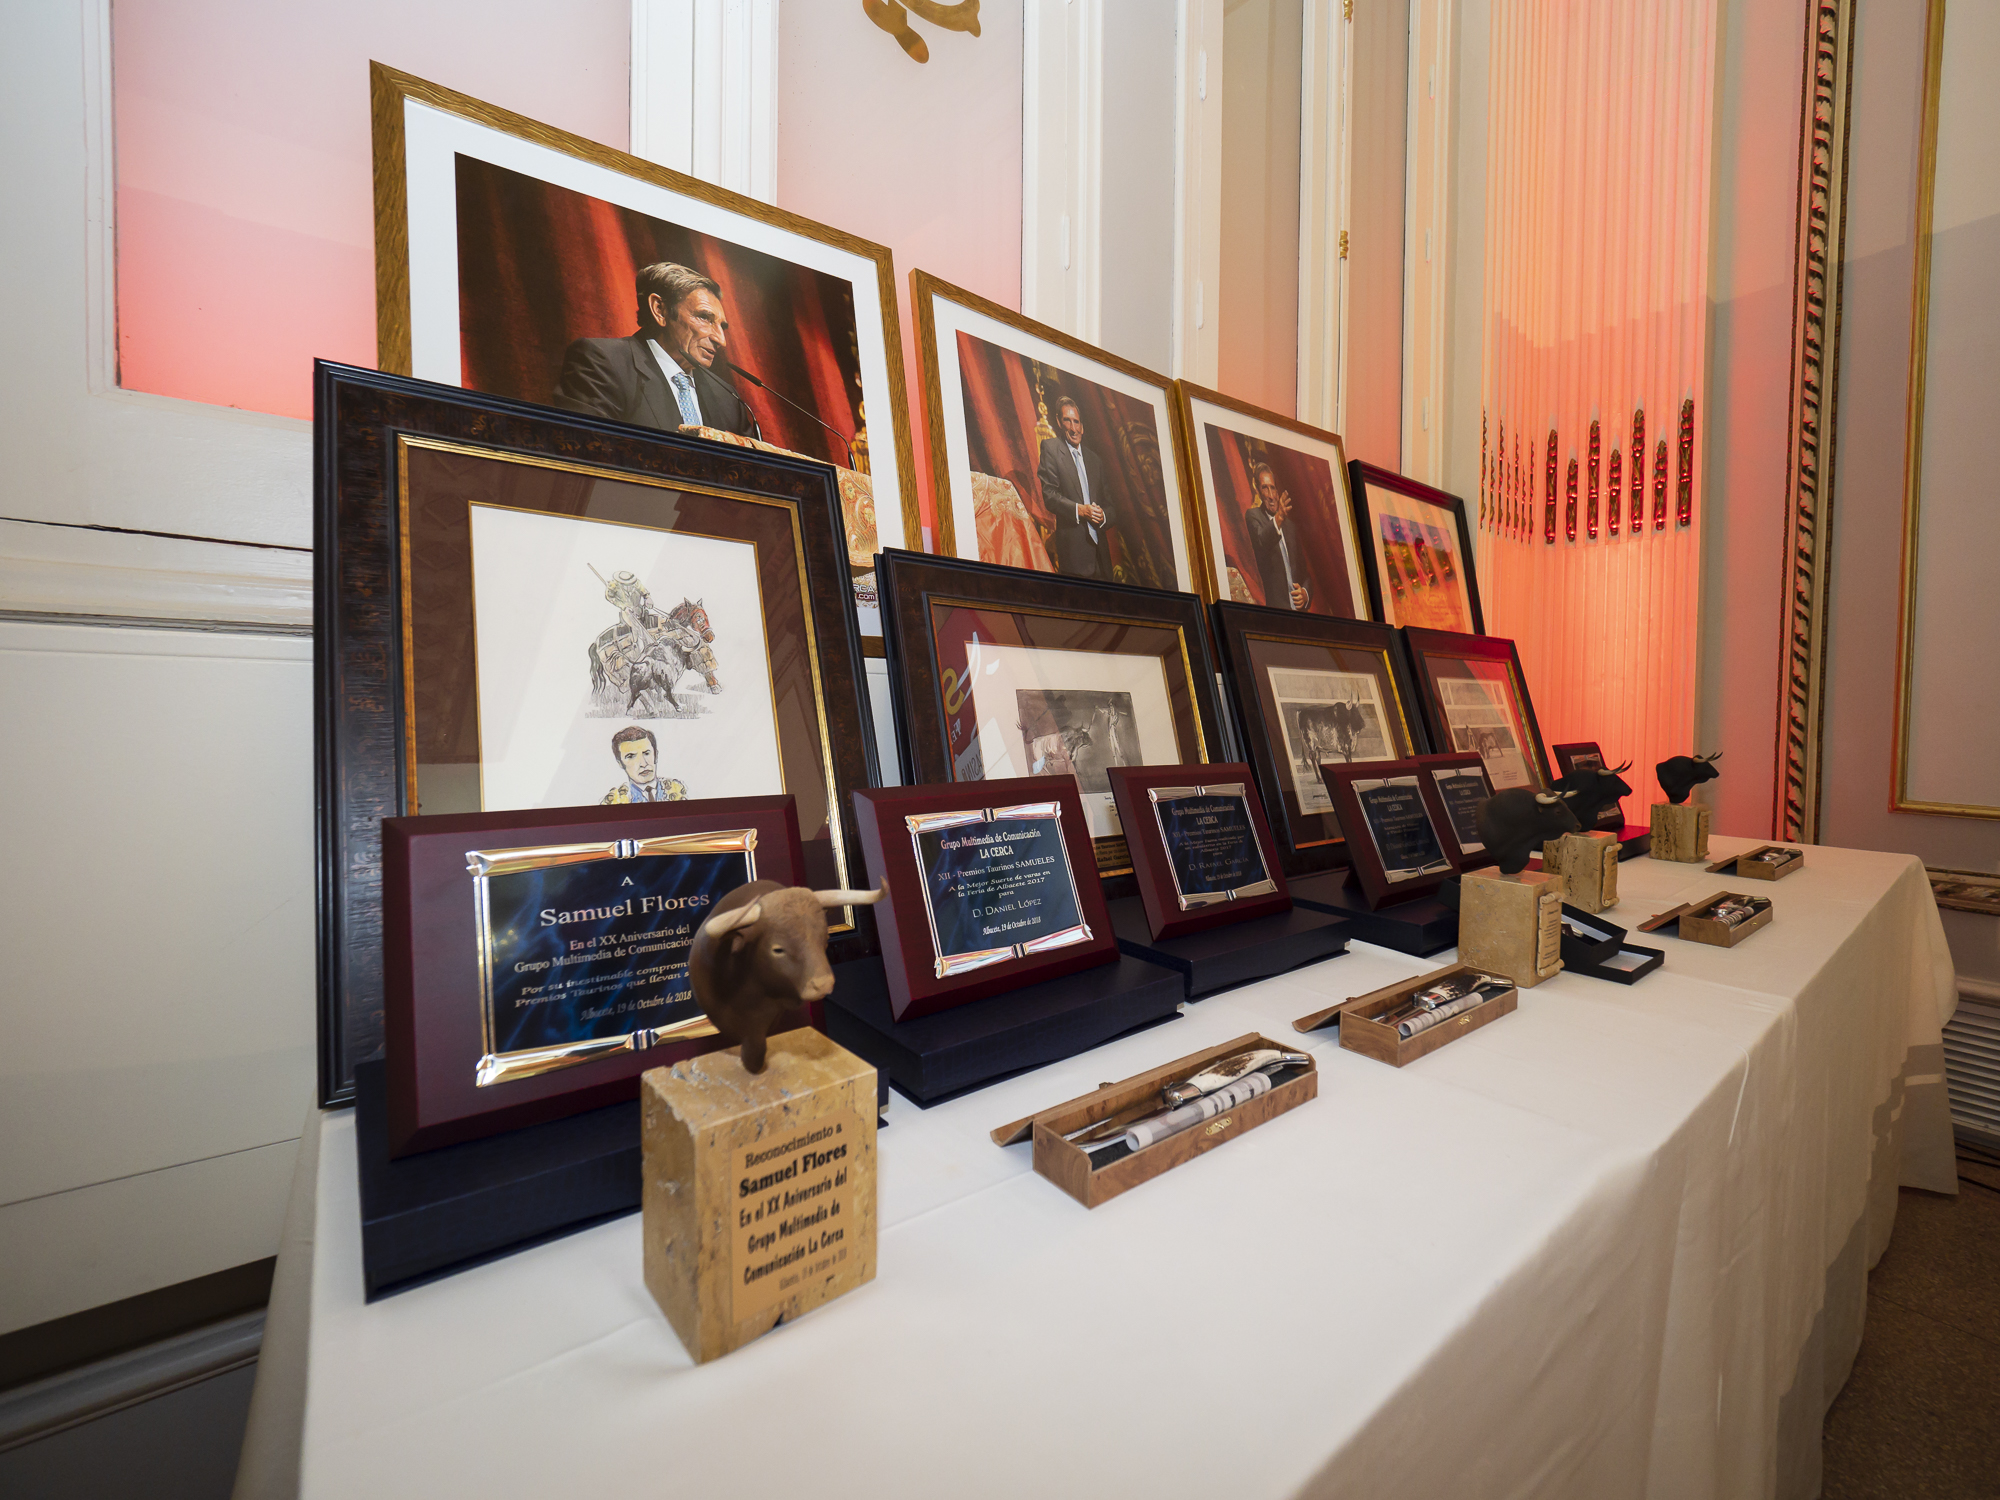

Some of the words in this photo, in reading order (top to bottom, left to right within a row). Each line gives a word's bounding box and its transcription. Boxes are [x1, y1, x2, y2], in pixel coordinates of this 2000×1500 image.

[1195, 817, 1203, 825] LA
[1203, 815, 1219, 824] CERCA
[940, 839, 961, 850] Grupo
[961, 834, 995, 847] Multimedia
[995, 833, 1003, 842] de
[1003, 828, 1042, 842] Comunicación
[979, 848, 990, 859] LA
[990, 845, 1014, 857] CERCA
[937, 871, 951, 881] XII
[957, 867, 986, 878] Premios
[986, 863, 1015, 874] Taurinos
[1015, 855, 1055, 868] SAMUELES
[966, 881, 989, 890] Mejor
[990, 877, 1014, 885] Suerte
[1023, 872, 1041, 880] varas
[621, 876, 634, 887] A
[957, 890, 965, 898] la
[967, 888, 985, 896] Feria
[996, 880, 1026, 891] Albacete
[1027, 877, 1045, 886] 2017
[998, 890, 1014, 899] para
[540, 899, 634, 927] Samuel
[640, 894, 710, 914] Flores
[972, 908, 984, 918] D.
[570, 940, 585, 951] En
[586, 938, 597, 948] el
[599, 935, 620, 947] XX
[619, 927, 674, 943] Aniversario
[676, 924, 690, 935] del
[514, 960, 550, 974] Grupo
[552, 950, 612, 967] Multimedia
[614, 947, 627, 957] de
[628, 937, 694, 954] Comunicación
[514, 992, 567, 1008] Premios
[570, 983, 623, 997] Taurinos
[626, 978, 647, 989] que
[649, 972, 682, 985] llevan
[521, 985, 545, 996] Por
[548, 982, 564, 990] su
[566, 969, 634, 988] inestimable
[617, 1003, 627, 1013] 19
[627, 1000, 636, 1012] de
[636, 993, 665, 1010] Octubre
[665, 992, 674, 1003] de
[674, 990, 692, 1002] 2018
[745, 1126, 834, 1169] Reconocimiento
[836, 1123, 842, 1134] a
[739, 1158, 798, 1198] Samuel
[802, 1143, 847, 1173] Flores
[740, 1208, 752, 1229] En
[755, 1200, 764, 1222] el
[767, 1193, 781, 1217] XX
[783, 1176, 832, 1212] Aniversario
[834, 1166, 847, 1187] del
[747, 1230, 776, 1254] Grupo
[779, 1205, 828, 1240] Multimedia
[830, 1198, 840, 1217] de
[744, 1244, 805, 1286] Comunicación
[808, 1236, 818, 1255] La
[821, 1227, 844, 1249] Cerca
